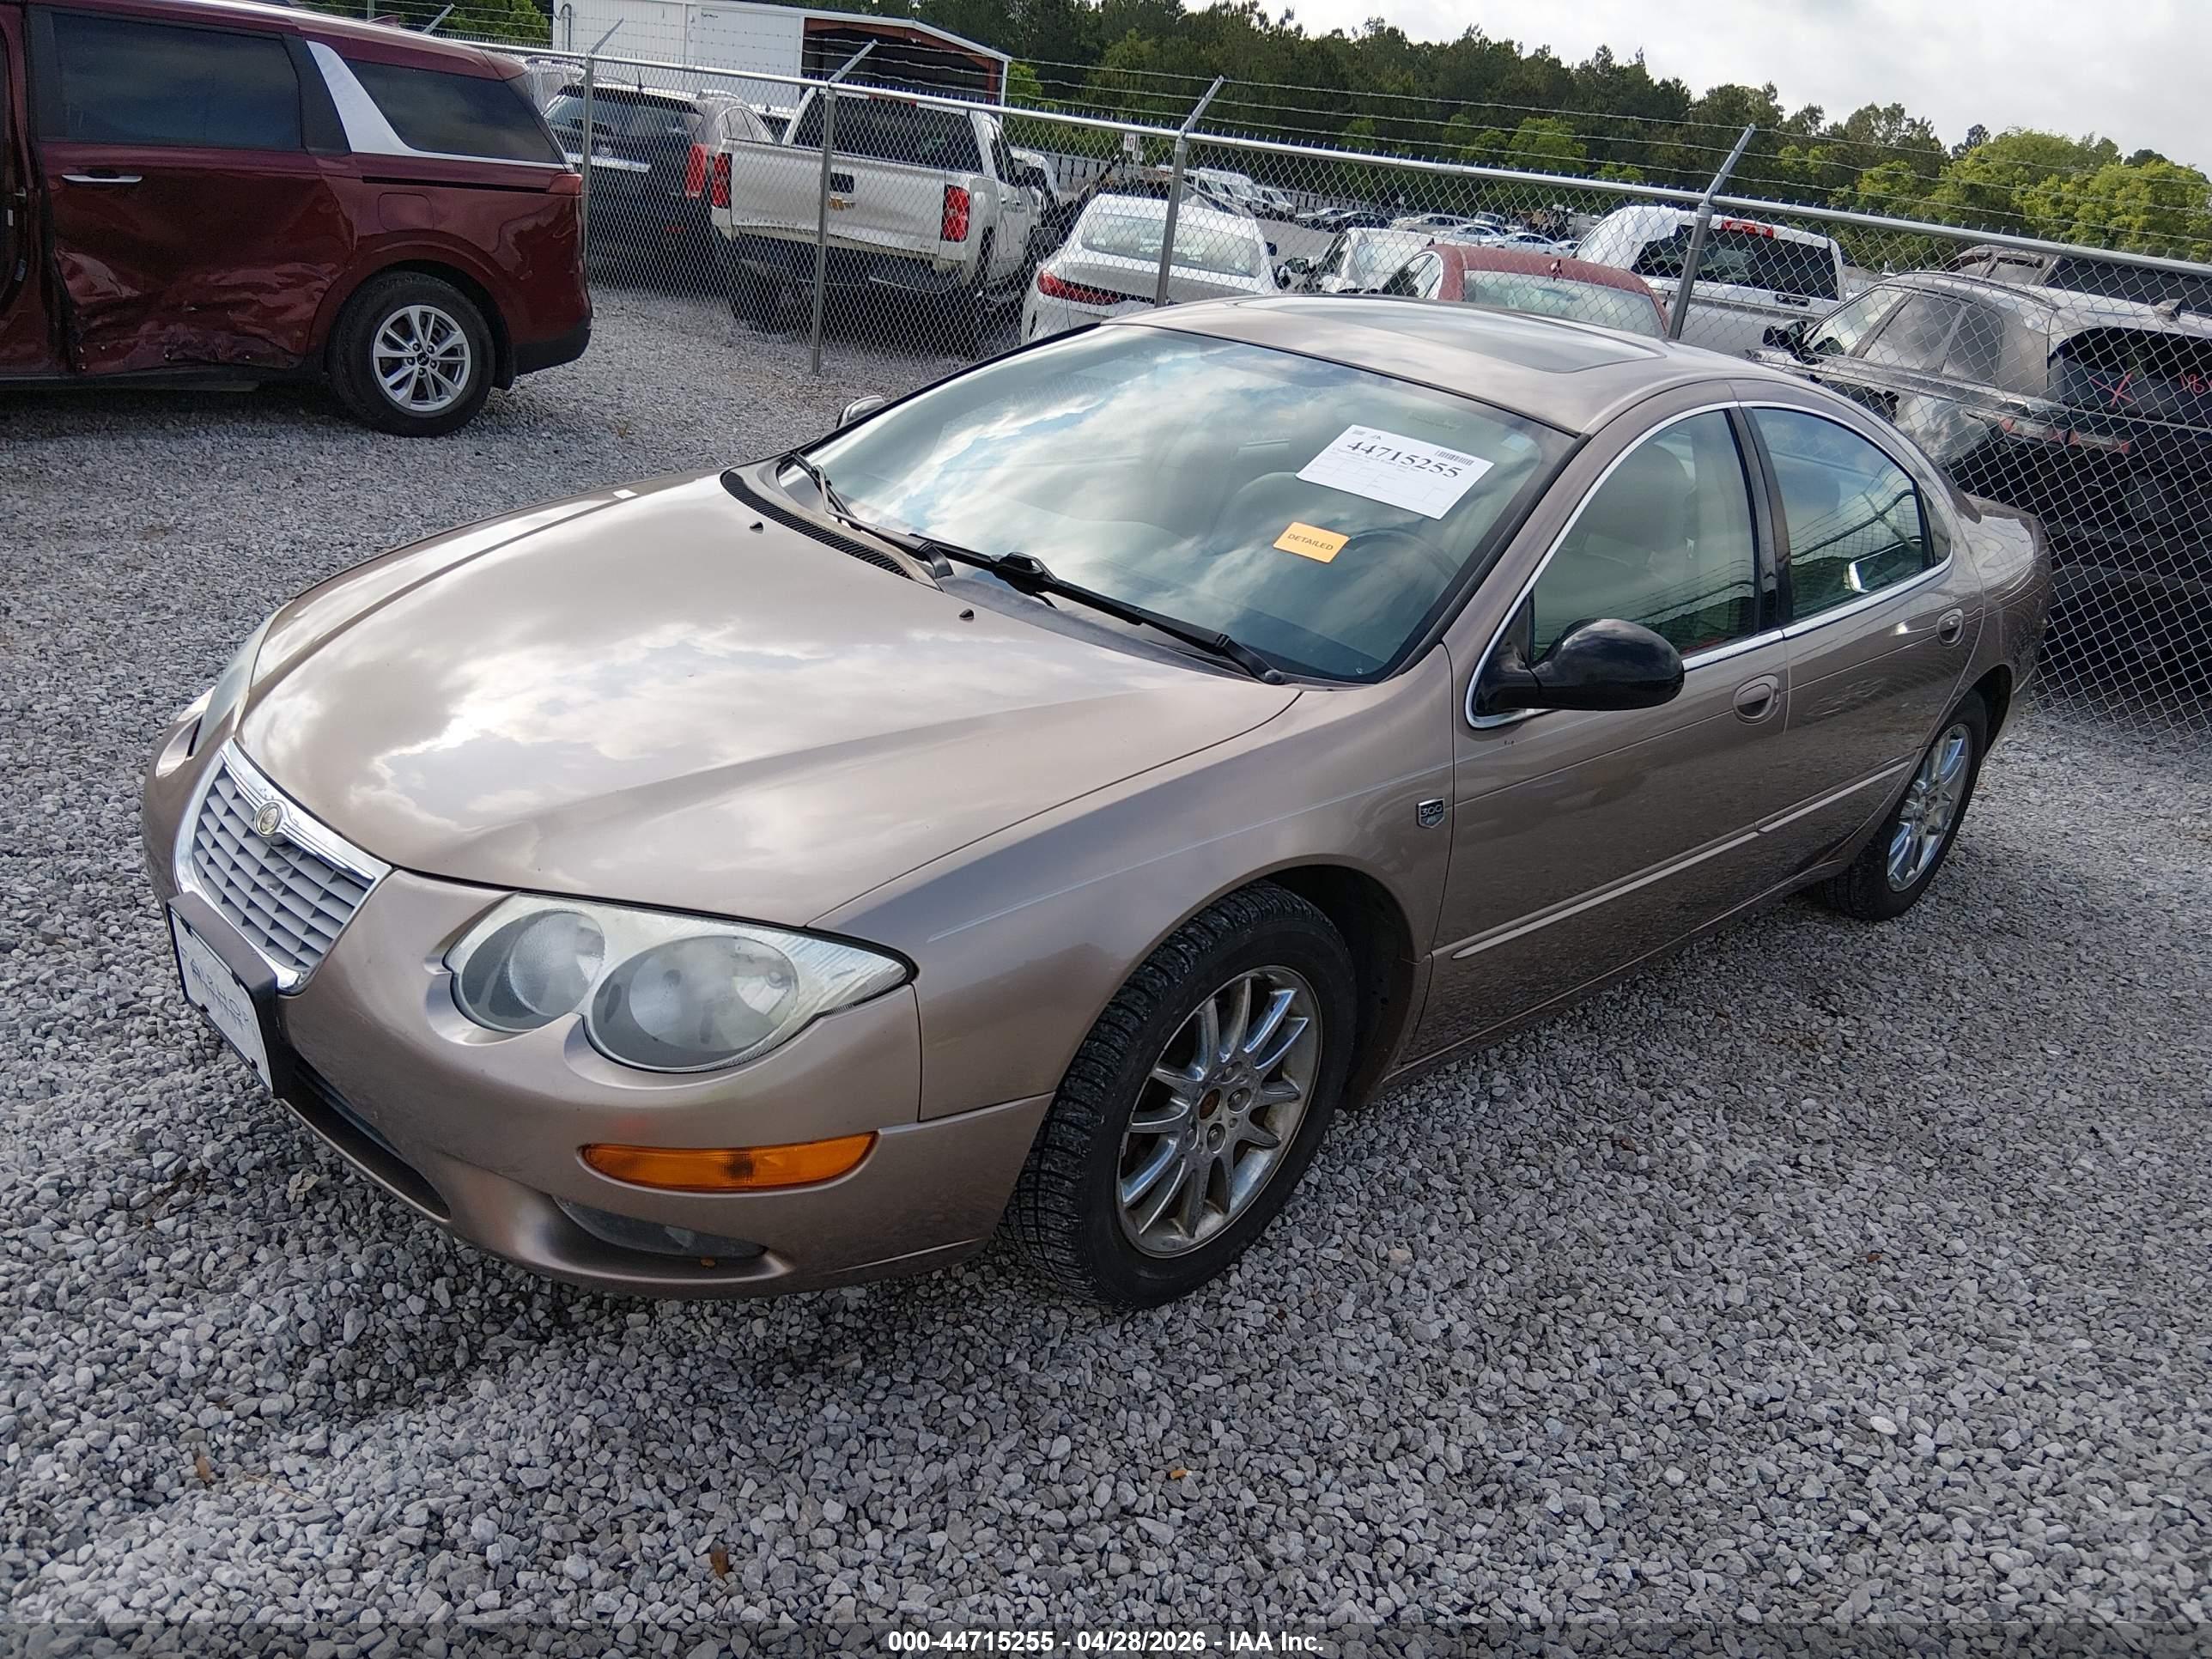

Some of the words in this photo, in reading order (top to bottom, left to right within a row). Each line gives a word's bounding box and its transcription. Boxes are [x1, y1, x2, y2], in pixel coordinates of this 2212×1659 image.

[1347, 441, 1462, 477] 44715255
[1288, 533, 1334, 550] DETAILED
[1420, 805, 1443, 817] 300
